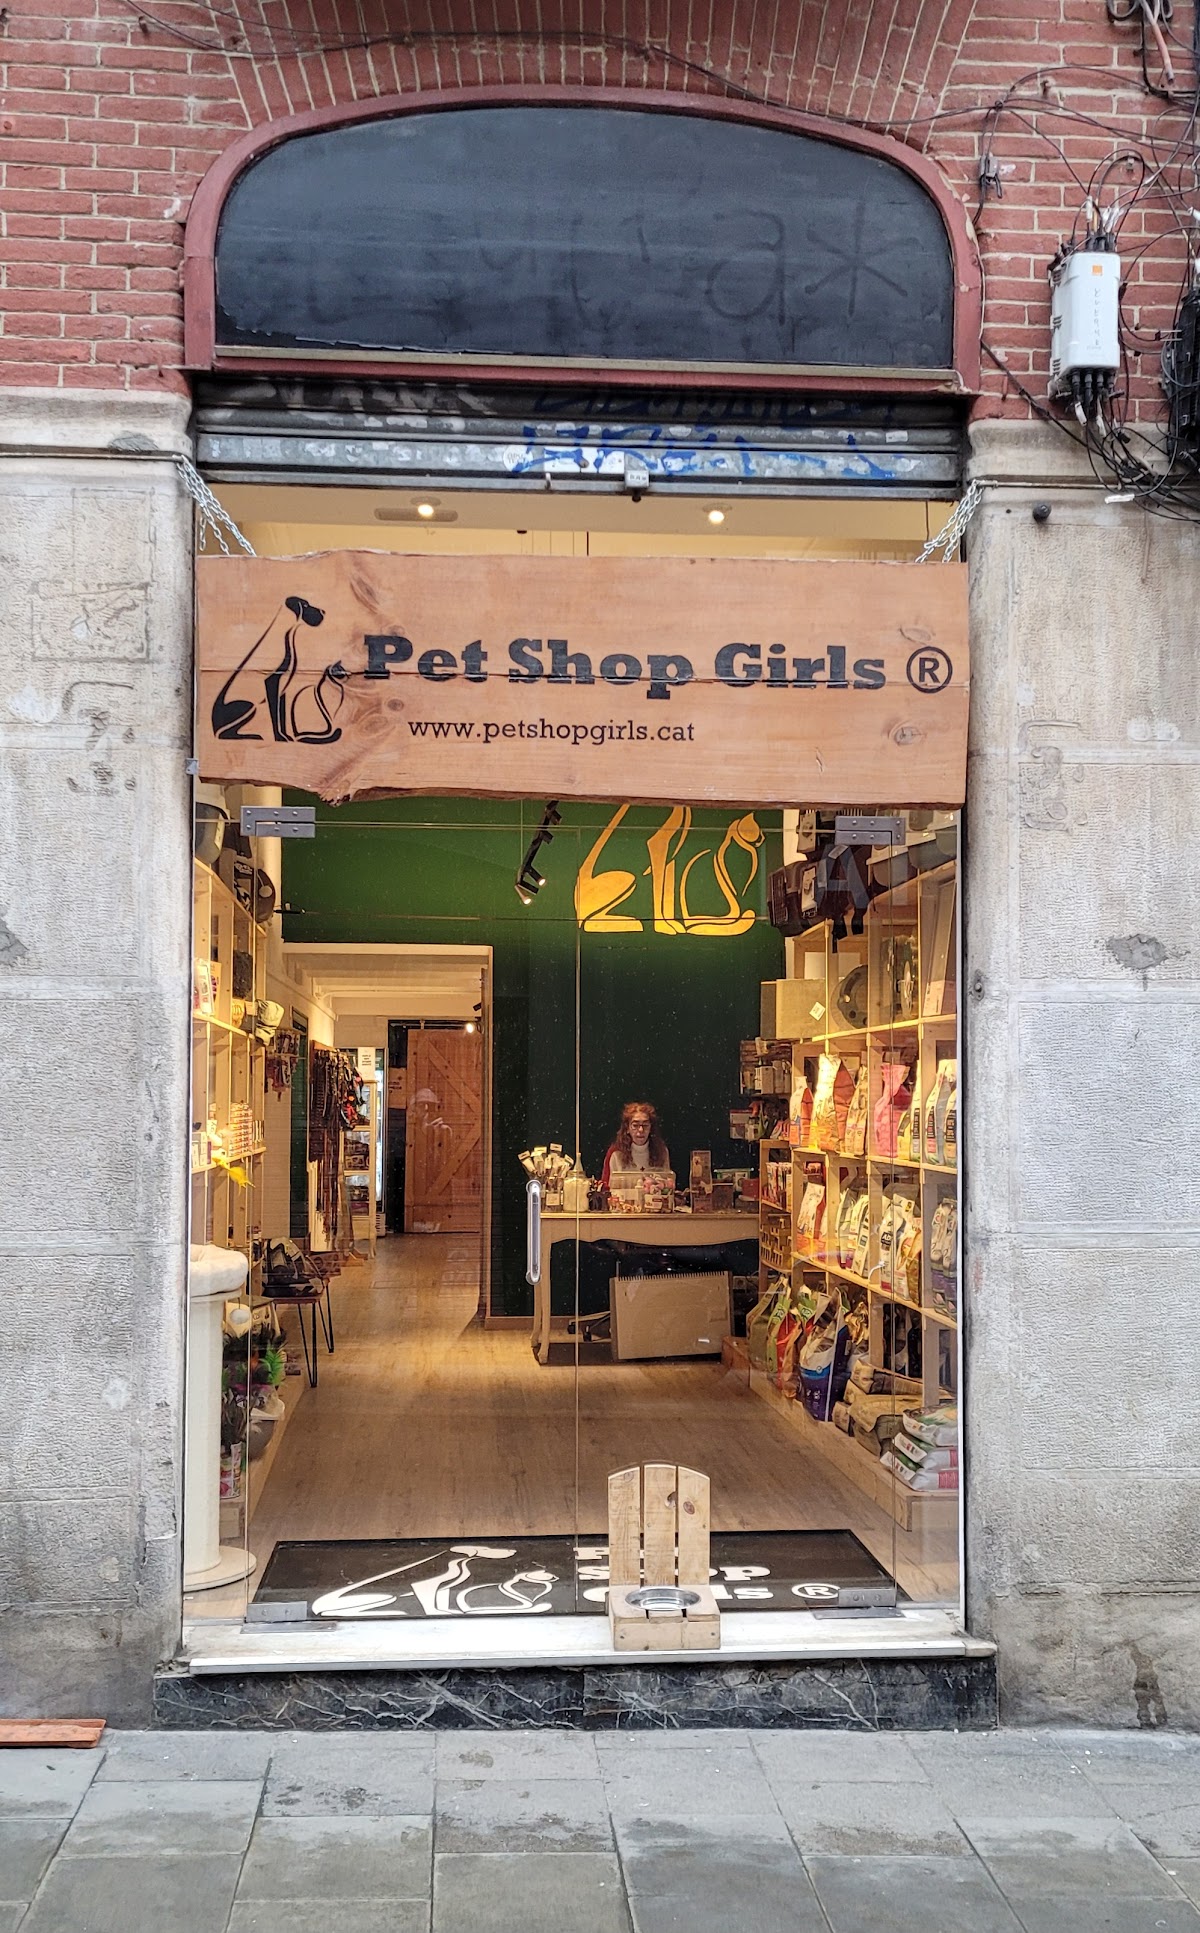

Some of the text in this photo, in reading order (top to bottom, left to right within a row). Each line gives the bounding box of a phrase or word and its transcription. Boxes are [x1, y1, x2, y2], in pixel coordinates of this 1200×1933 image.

[364, 635, 488, 679] Pet
[508, 638, 695, 700] Shop
[715, 643, 885, 690] Girls
[407, 718, 695, 746] www.petshopgirls.cat
